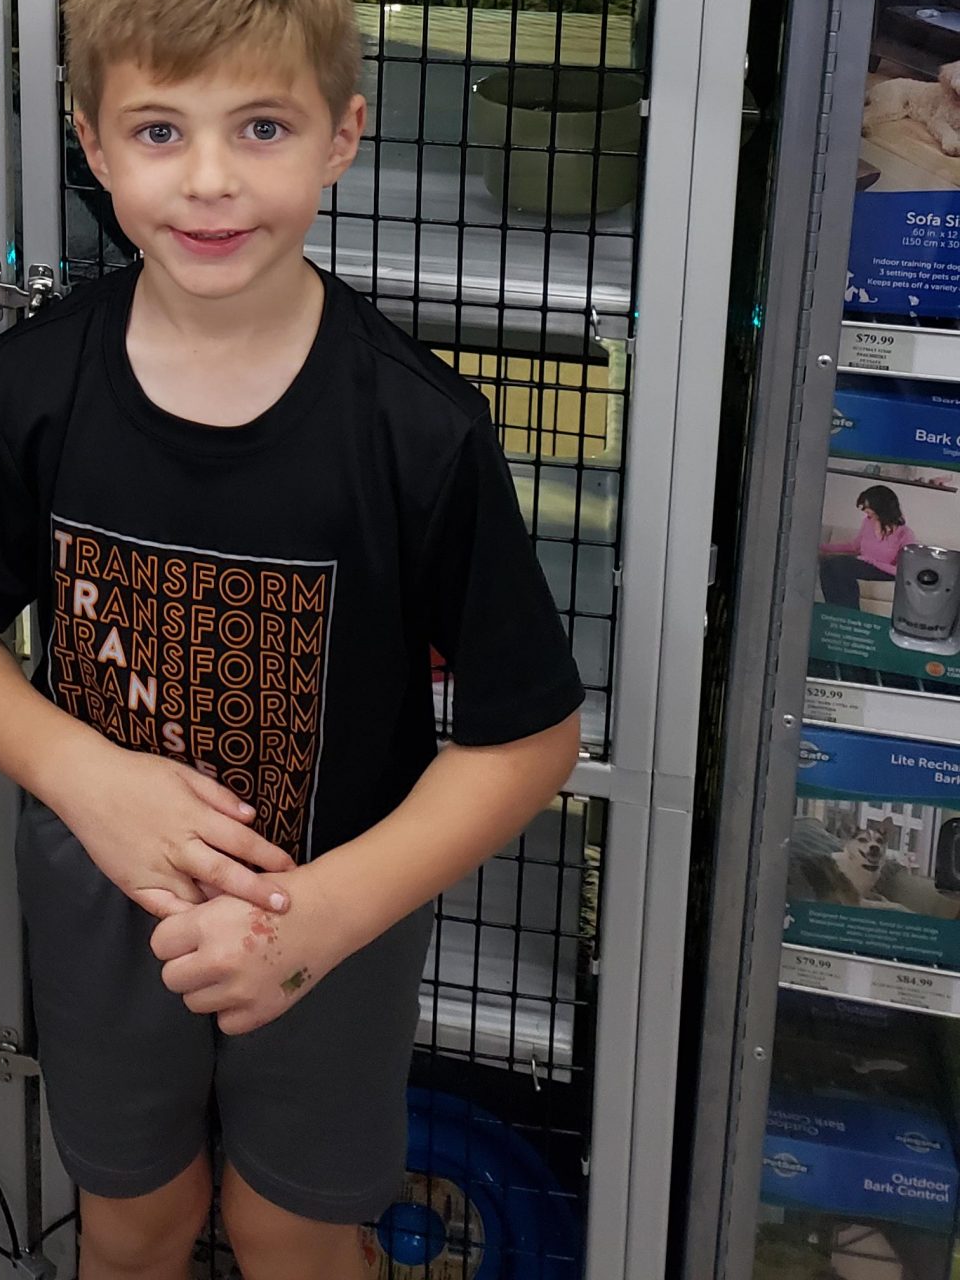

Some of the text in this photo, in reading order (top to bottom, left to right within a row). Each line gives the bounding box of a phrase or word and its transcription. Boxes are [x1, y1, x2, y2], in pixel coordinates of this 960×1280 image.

[906, 211, 960, 227] Sofa Si
[913, 228, 925, 236] 60
[902, 238, 921, 246] (150
[872, 258, 899, 266] Indoor
[902, 260, 931, 269] training
[886, 270, 917, 279] settings
[932, 272, 949, 280] pets
[867, 278, 891, 287] Keeps
[893, 280, 909, 288] pets
[911, 281, 922, 289] off
[931, 283, 958, 292] variety
[856, 332, 894, 345] $79.99
[915, 429, 951, 446] Bark
[54, 530, 325, 613] TRANSFORM
[54, 572, 323, 656] TRANSFORM
[54, 613, 320, 694] TRANSFORM
[54, 649, 318, 733] TRANSFORM
[806, 688, 843, 699] $29.99
[59, 683, 314, 772] TRANSFORM
[891, 754, 915, 766] Lite
[795, 956, 831, 969] $79.99
[896, 975, 933, 987] $84.99
[892, 1173, 950, 1191] Outdoor
[863, 1179, 949, 1203] Bark Control
